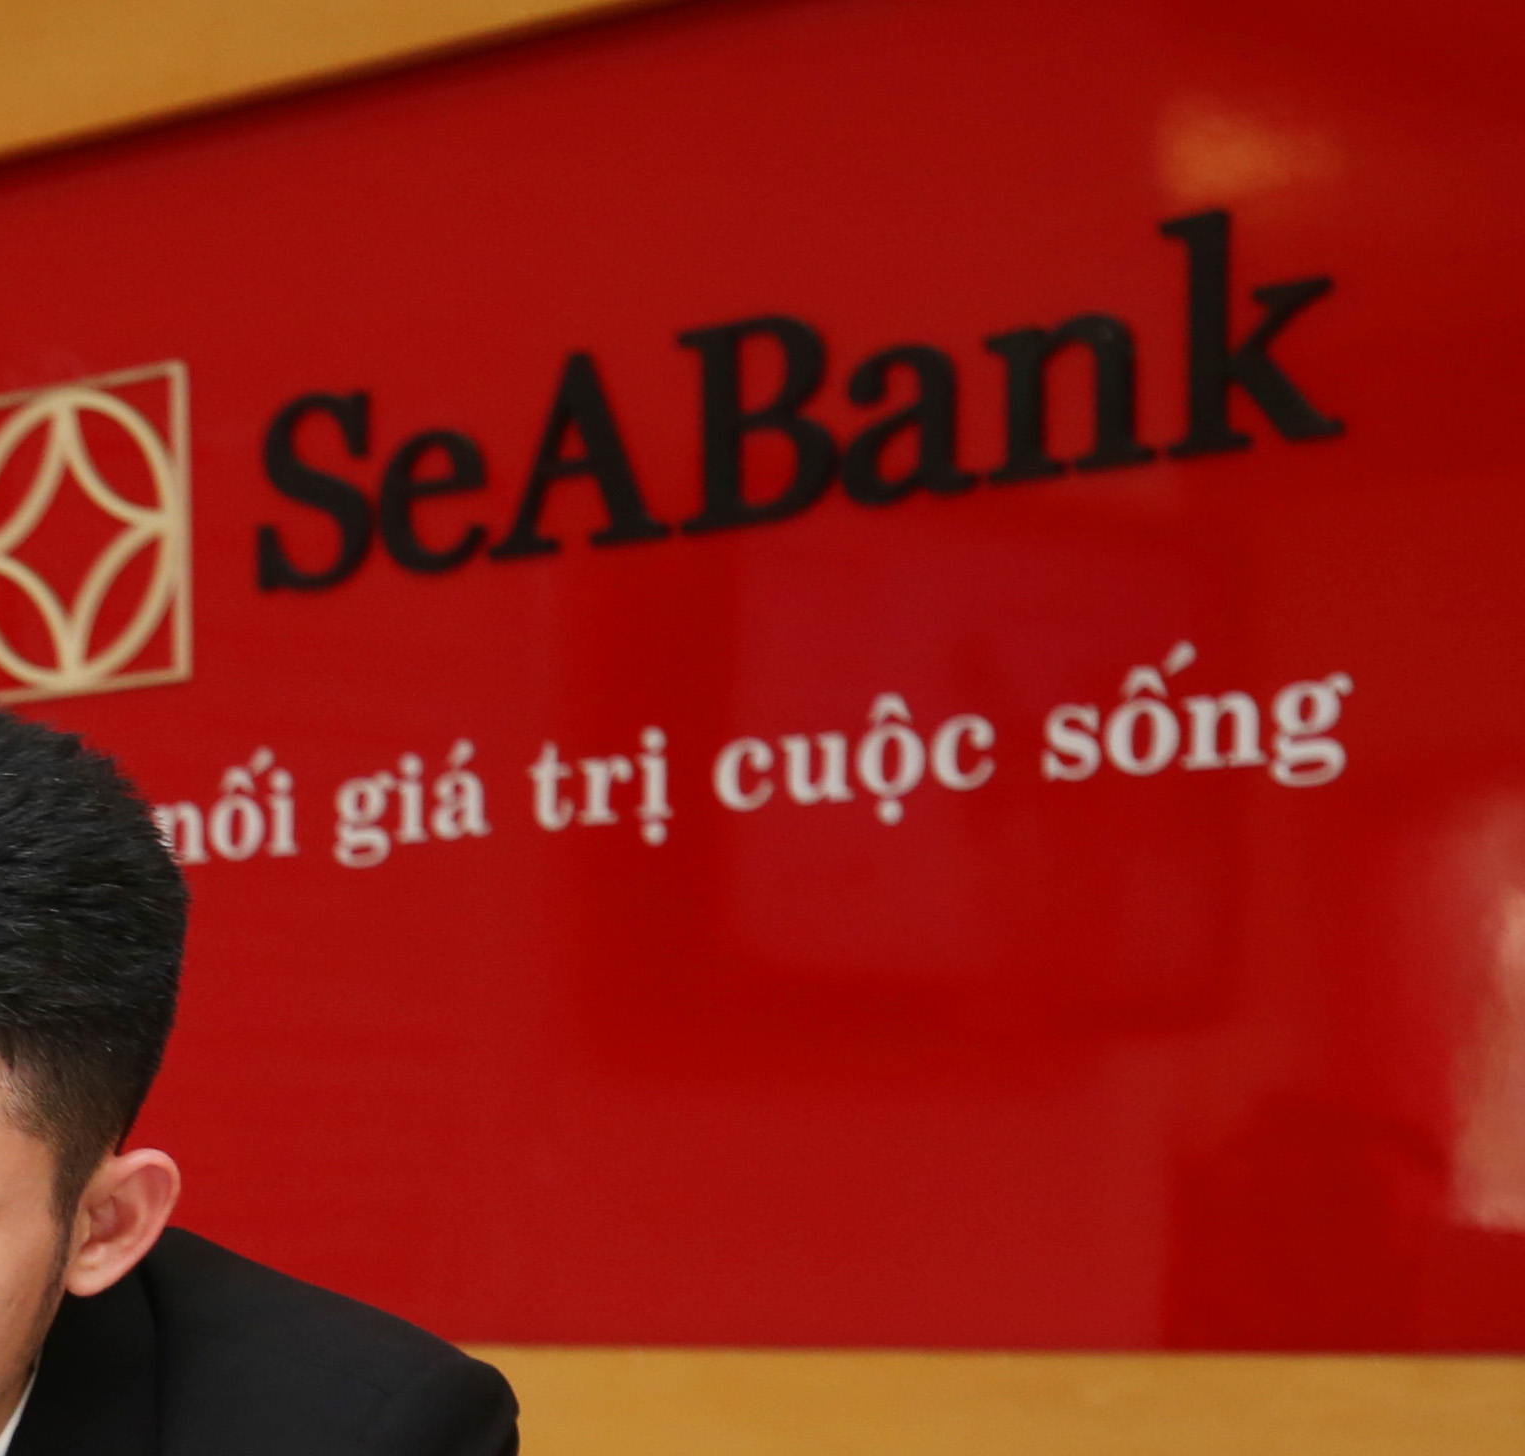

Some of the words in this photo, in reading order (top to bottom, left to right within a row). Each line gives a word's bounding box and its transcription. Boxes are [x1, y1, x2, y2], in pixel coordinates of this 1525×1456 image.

[256, 210, 1344, 594] SeABank
[334, 737, 491, 869] giá
[527, 725, 673, 846] trị
[712, 691, 995, 825] cuộc
[1040, 640, 1353, 787] sống
